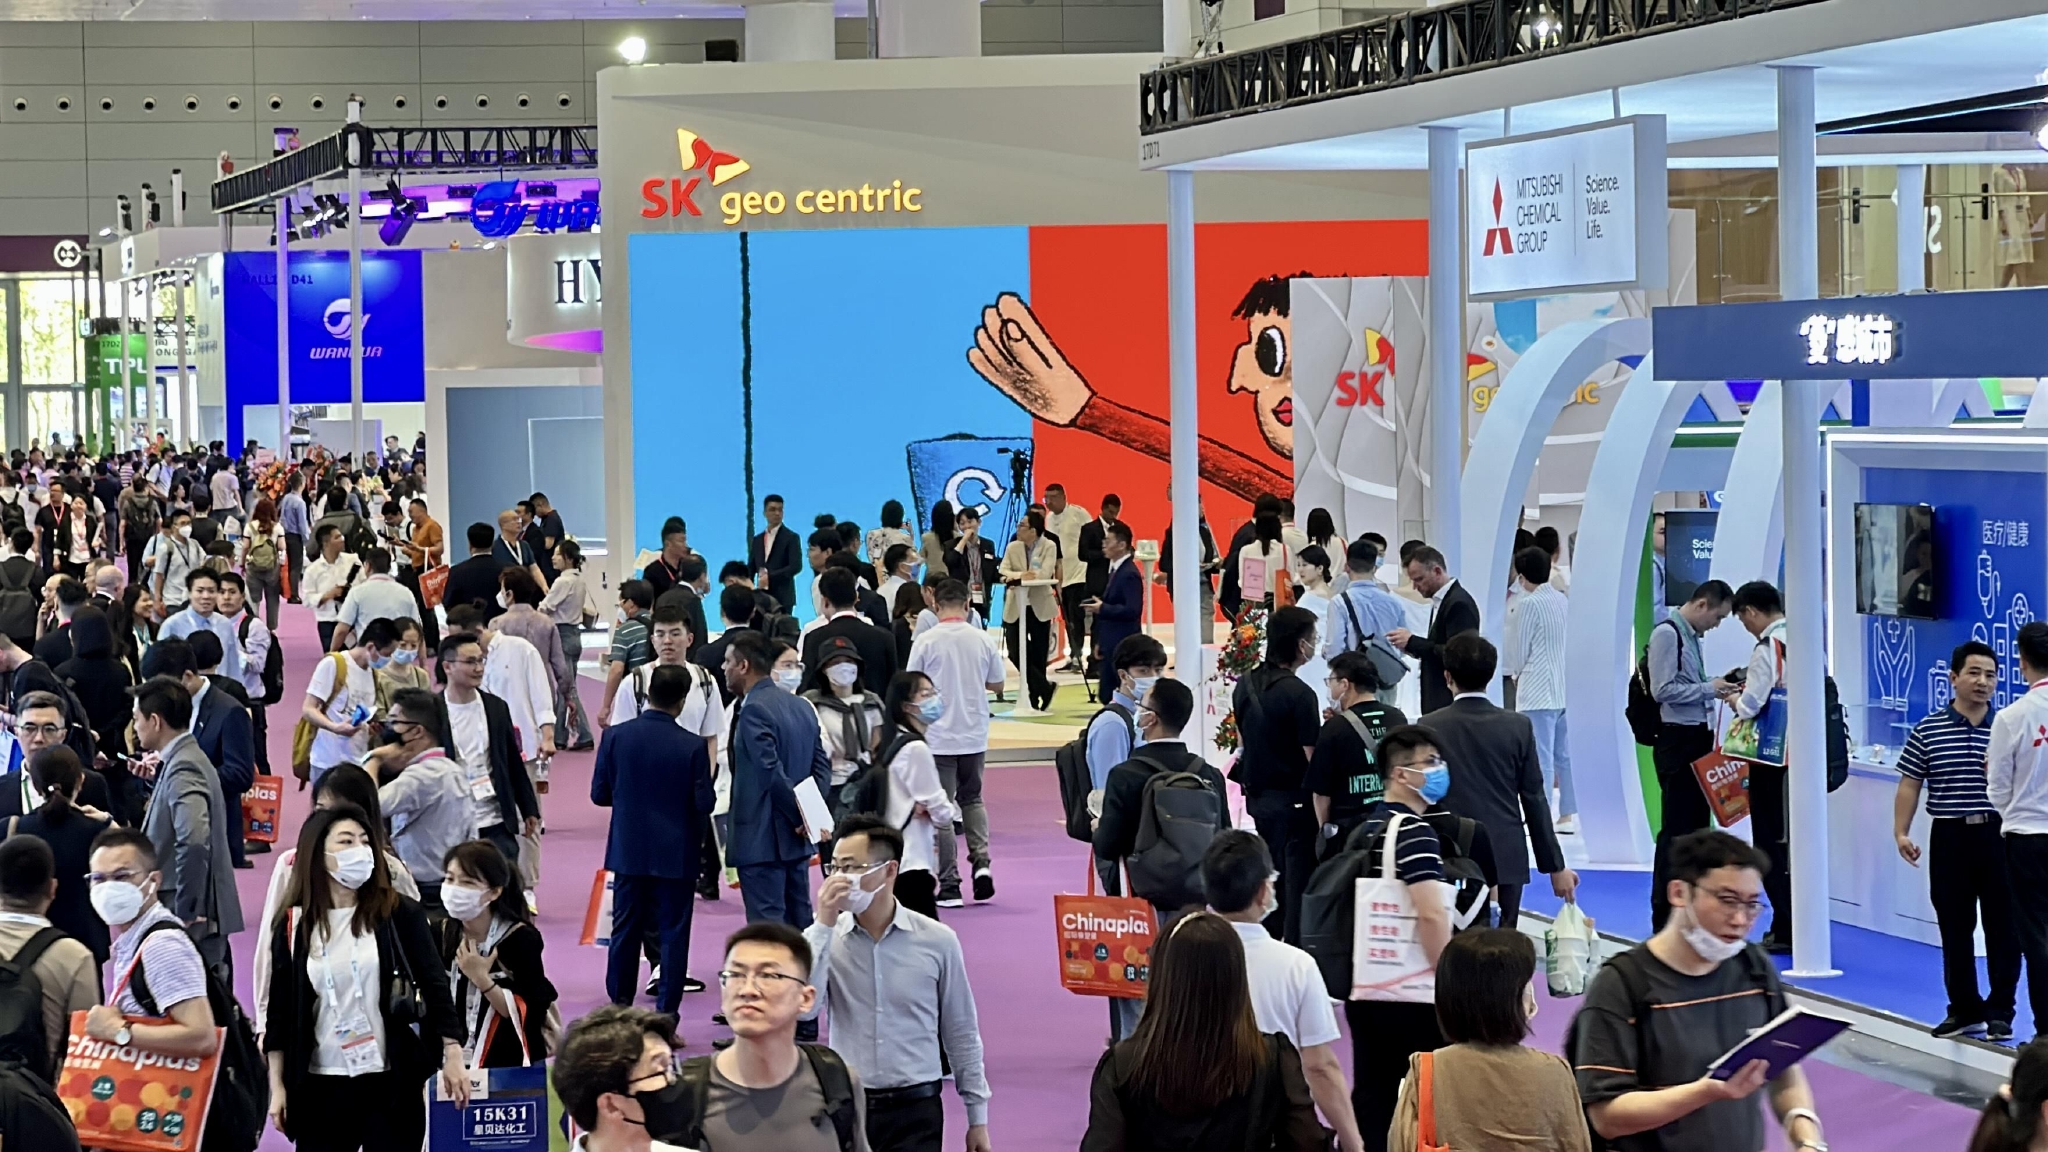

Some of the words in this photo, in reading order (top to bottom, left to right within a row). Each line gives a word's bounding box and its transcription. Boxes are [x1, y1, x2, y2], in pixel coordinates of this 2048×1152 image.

[1517, 174, 1563, 199] MITSUBISHI
[1585, 174, 1619, 193] Science.
[641, 178, 702, 218] SK
[720, 190, 786, 225] geo
[796, 180, 922, 213] centric
[1586, 197, 1610, 215] Value.
[1517, 202, 1562, 226] CHEMICAL
[1586, 219, 1603, 238] Life.
[1517, 231, 1548, 253] GROUP
[291, 275, 314, 285] D41
[310, 347, 382, 359] WANUA
[1336, 371, 1385, 406] SK
[1983, 520, 2029, 547] 医疗/健康
[1692, 549, 1713, 558] Valu
[1062, 912, 1150, 938] Chinaplas
[473, 1106, 527, 1121] 15K31
